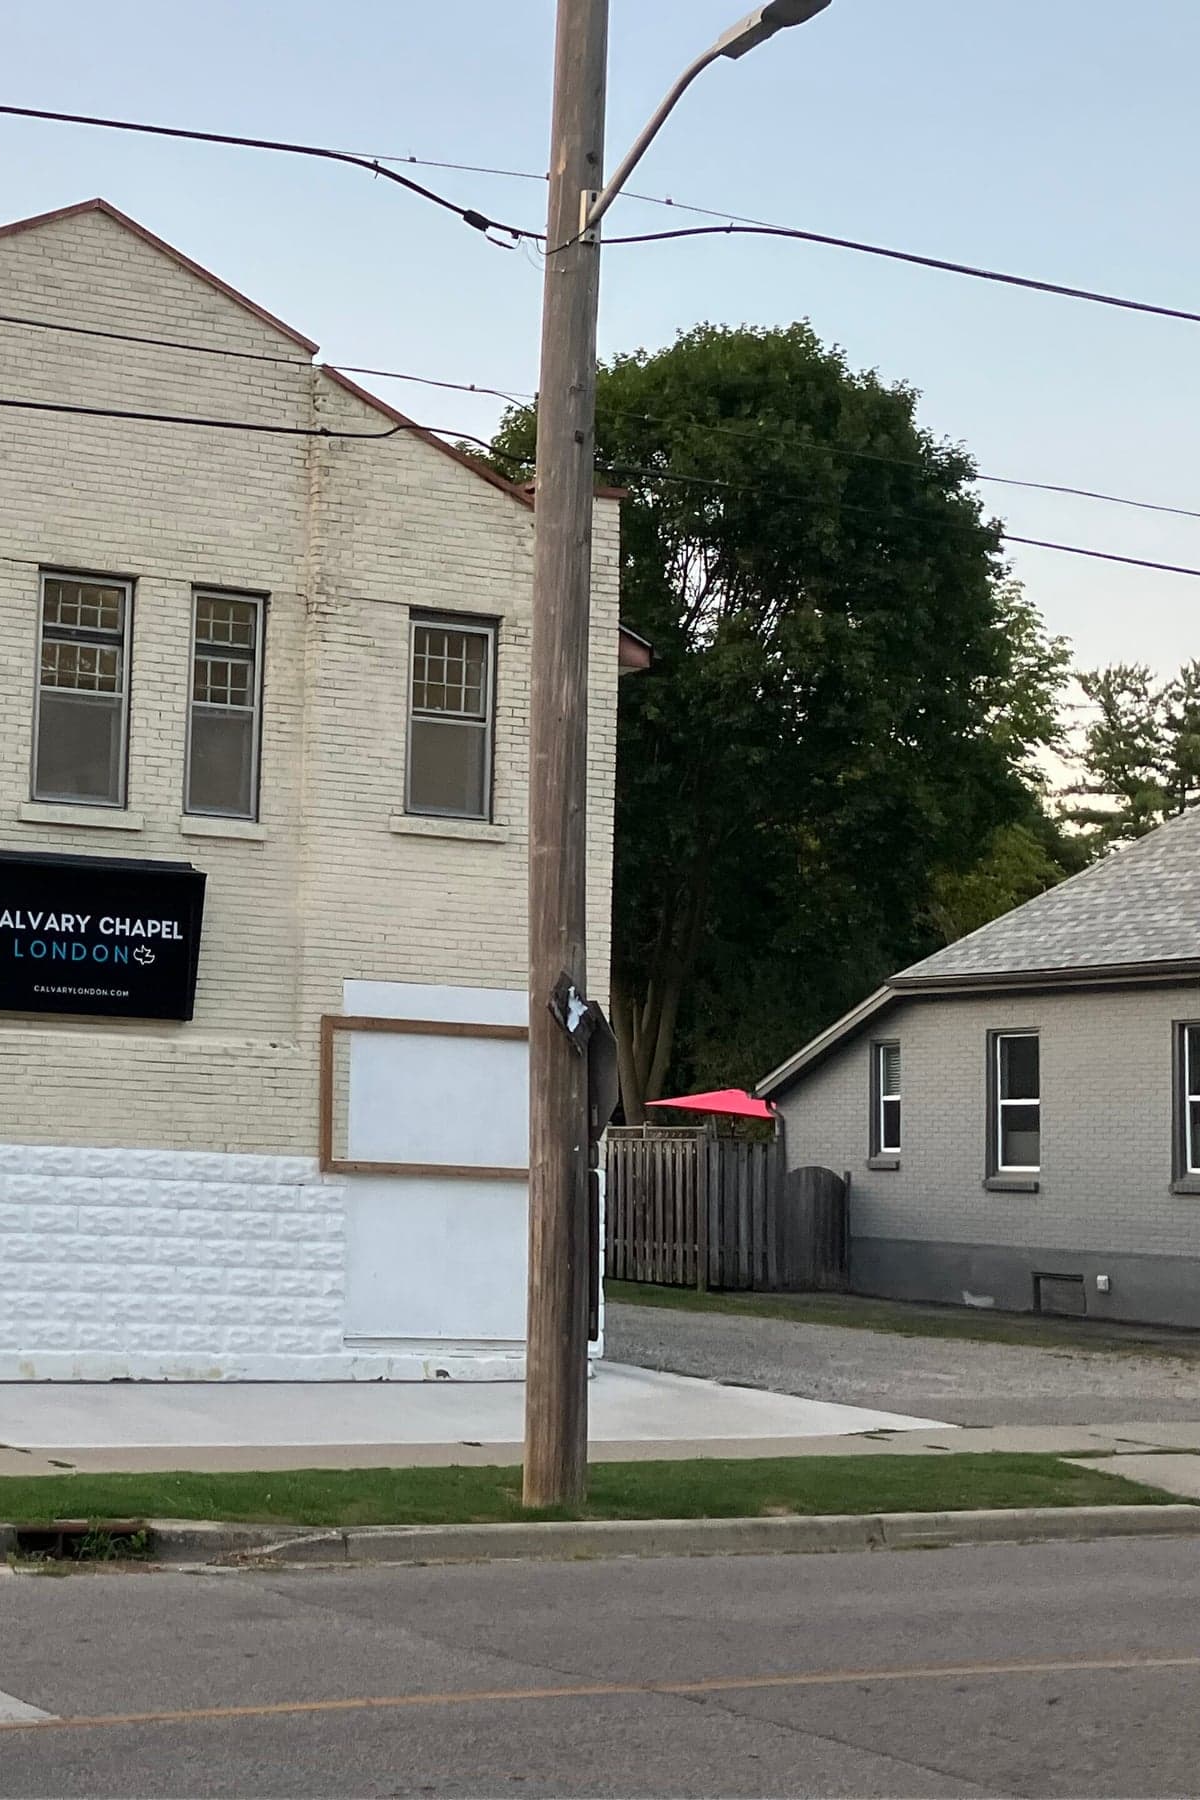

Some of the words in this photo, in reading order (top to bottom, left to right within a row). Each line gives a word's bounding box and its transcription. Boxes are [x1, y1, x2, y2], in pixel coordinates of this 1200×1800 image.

[99, 916, 184, 940] CHAPEL
[14, 938, 129, 965] LONDON
[33, 984, 130, 997] CALVARYLONDON.COM
